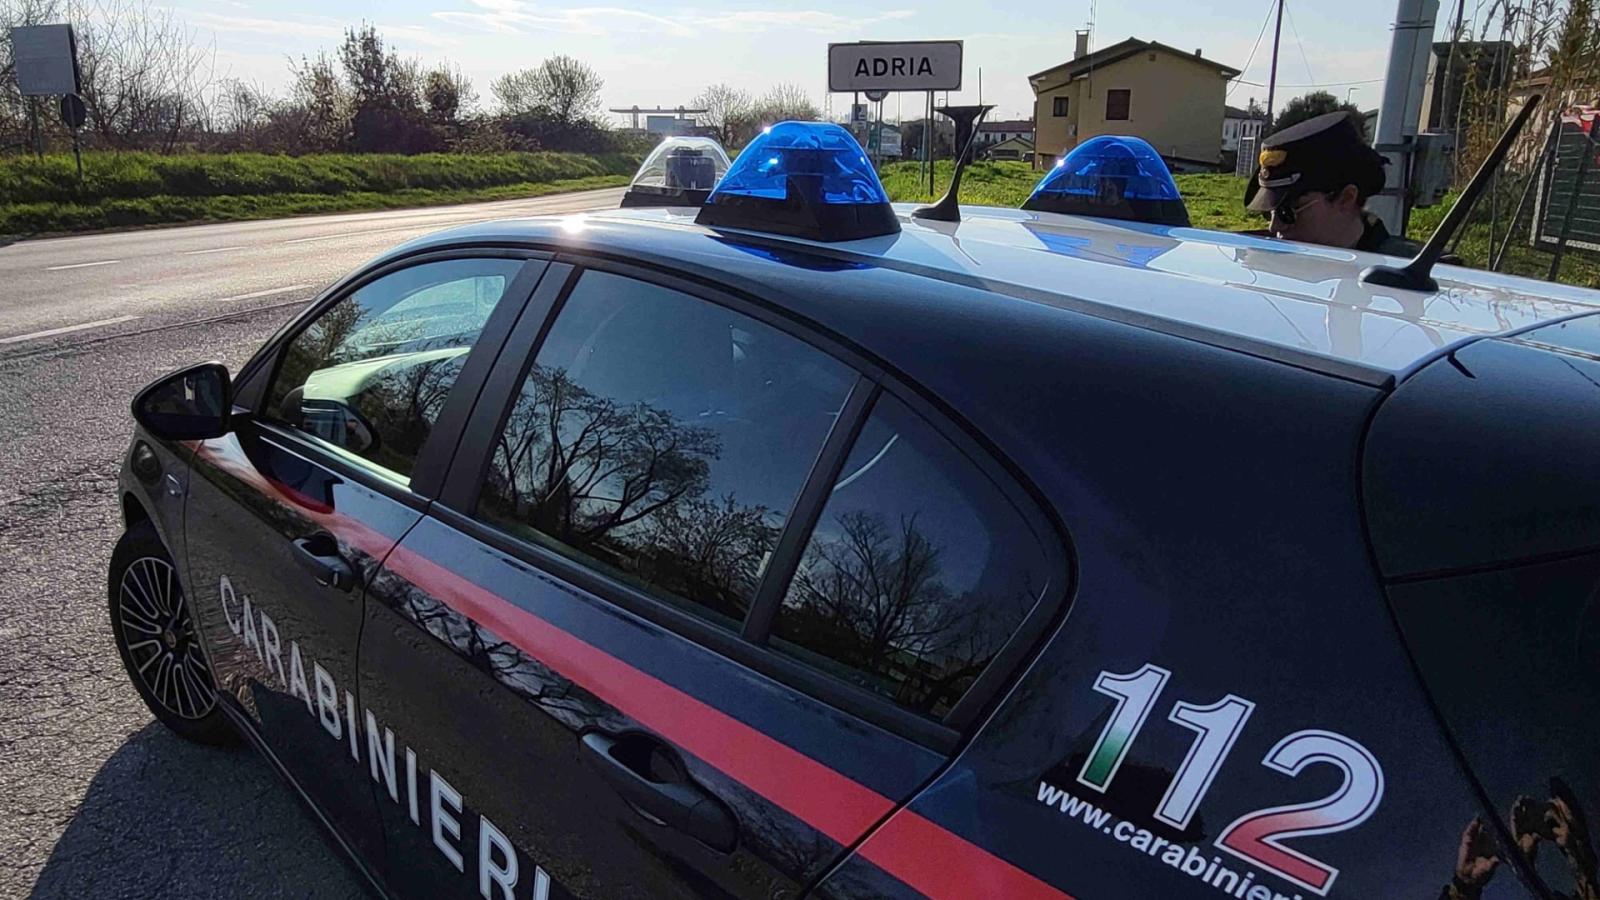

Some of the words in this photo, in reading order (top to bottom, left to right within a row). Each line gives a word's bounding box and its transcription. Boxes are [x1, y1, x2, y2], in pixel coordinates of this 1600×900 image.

[854, 57, 933, 77] ADRIA
[1076, 663, 1385, 897] 112
[1036, 781, 1303, 900] www.carabinie
